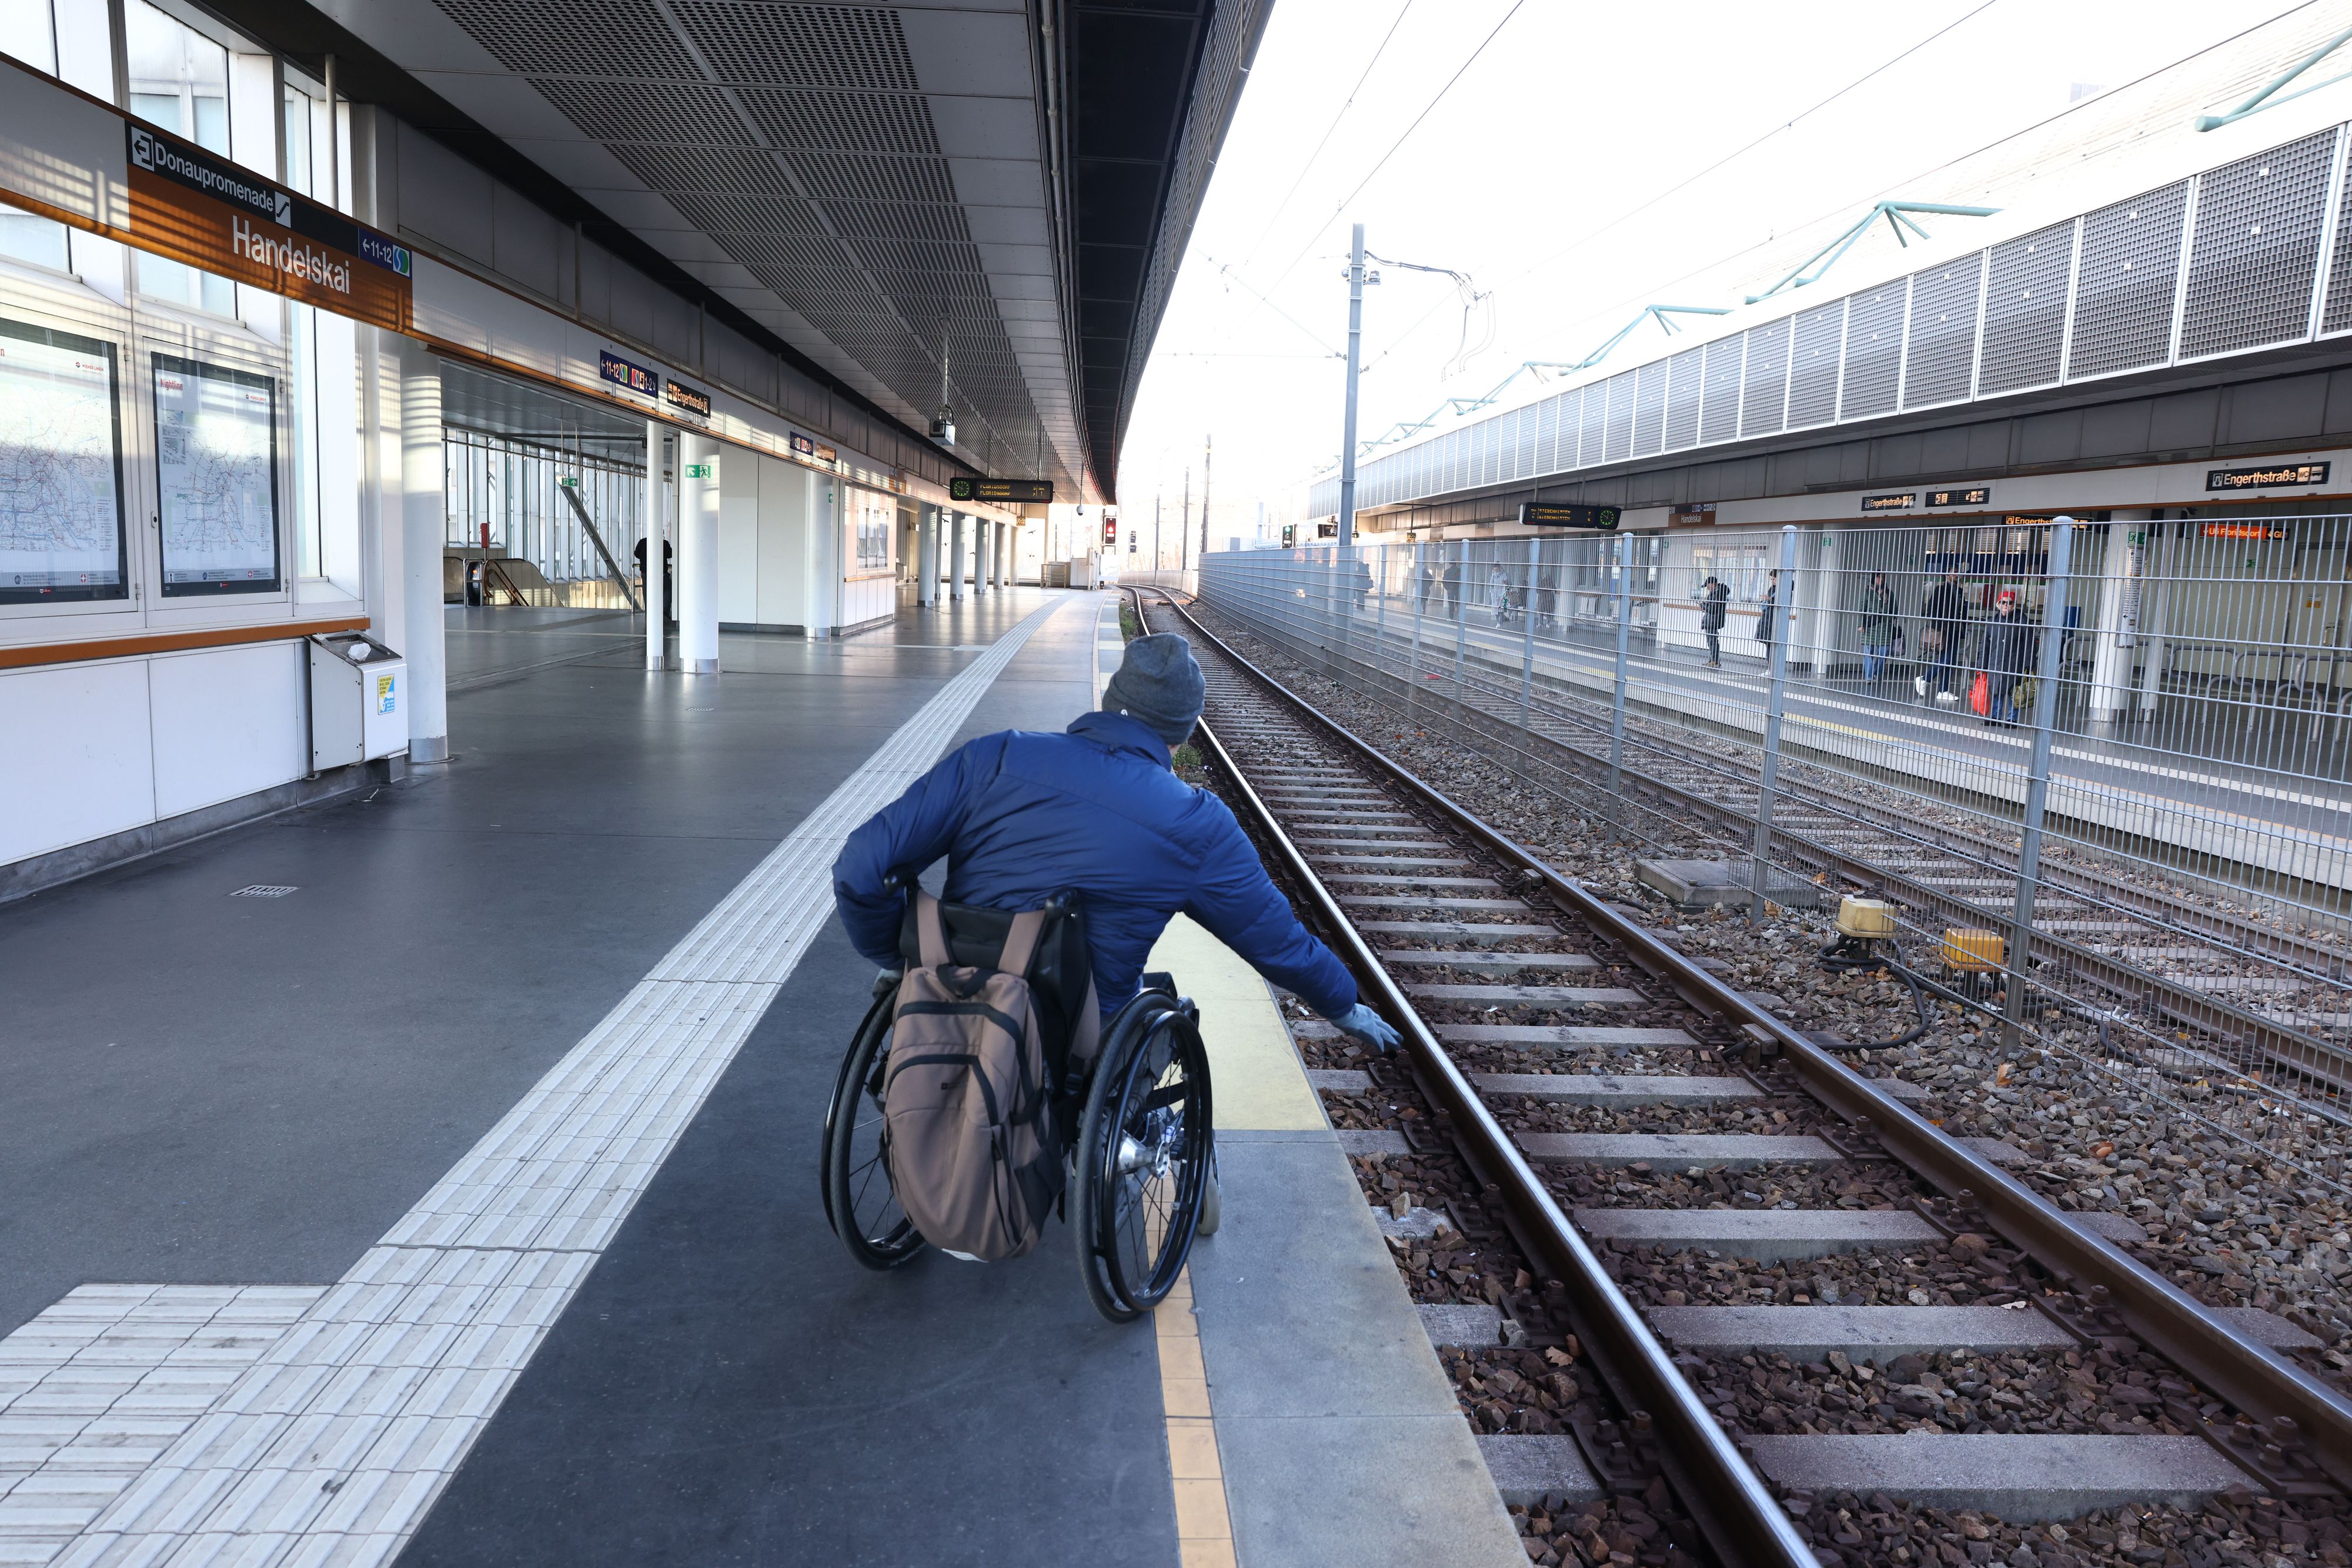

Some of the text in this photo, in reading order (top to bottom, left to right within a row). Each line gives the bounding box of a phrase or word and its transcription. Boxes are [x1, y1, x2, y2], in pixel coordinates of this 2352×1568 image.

[155, 142, 273, 212] Donaupromenade
[233, 215, 350, 295] Handelskai
[370, 240, 392, 264] 11-12
[606, 360, 619, 378] 11-12
[160, 378, 183, 391] Nightline
[677, 388, 704, 410] Engerthstraße
[2224, 469, 2296, 487] Engerthstraße
[1870, 497, 1902, 507] Engerthstraße
[1681, 513, 1702, 523] Handelskai
[2220, 528, 2261, 537] Foridsdorf
